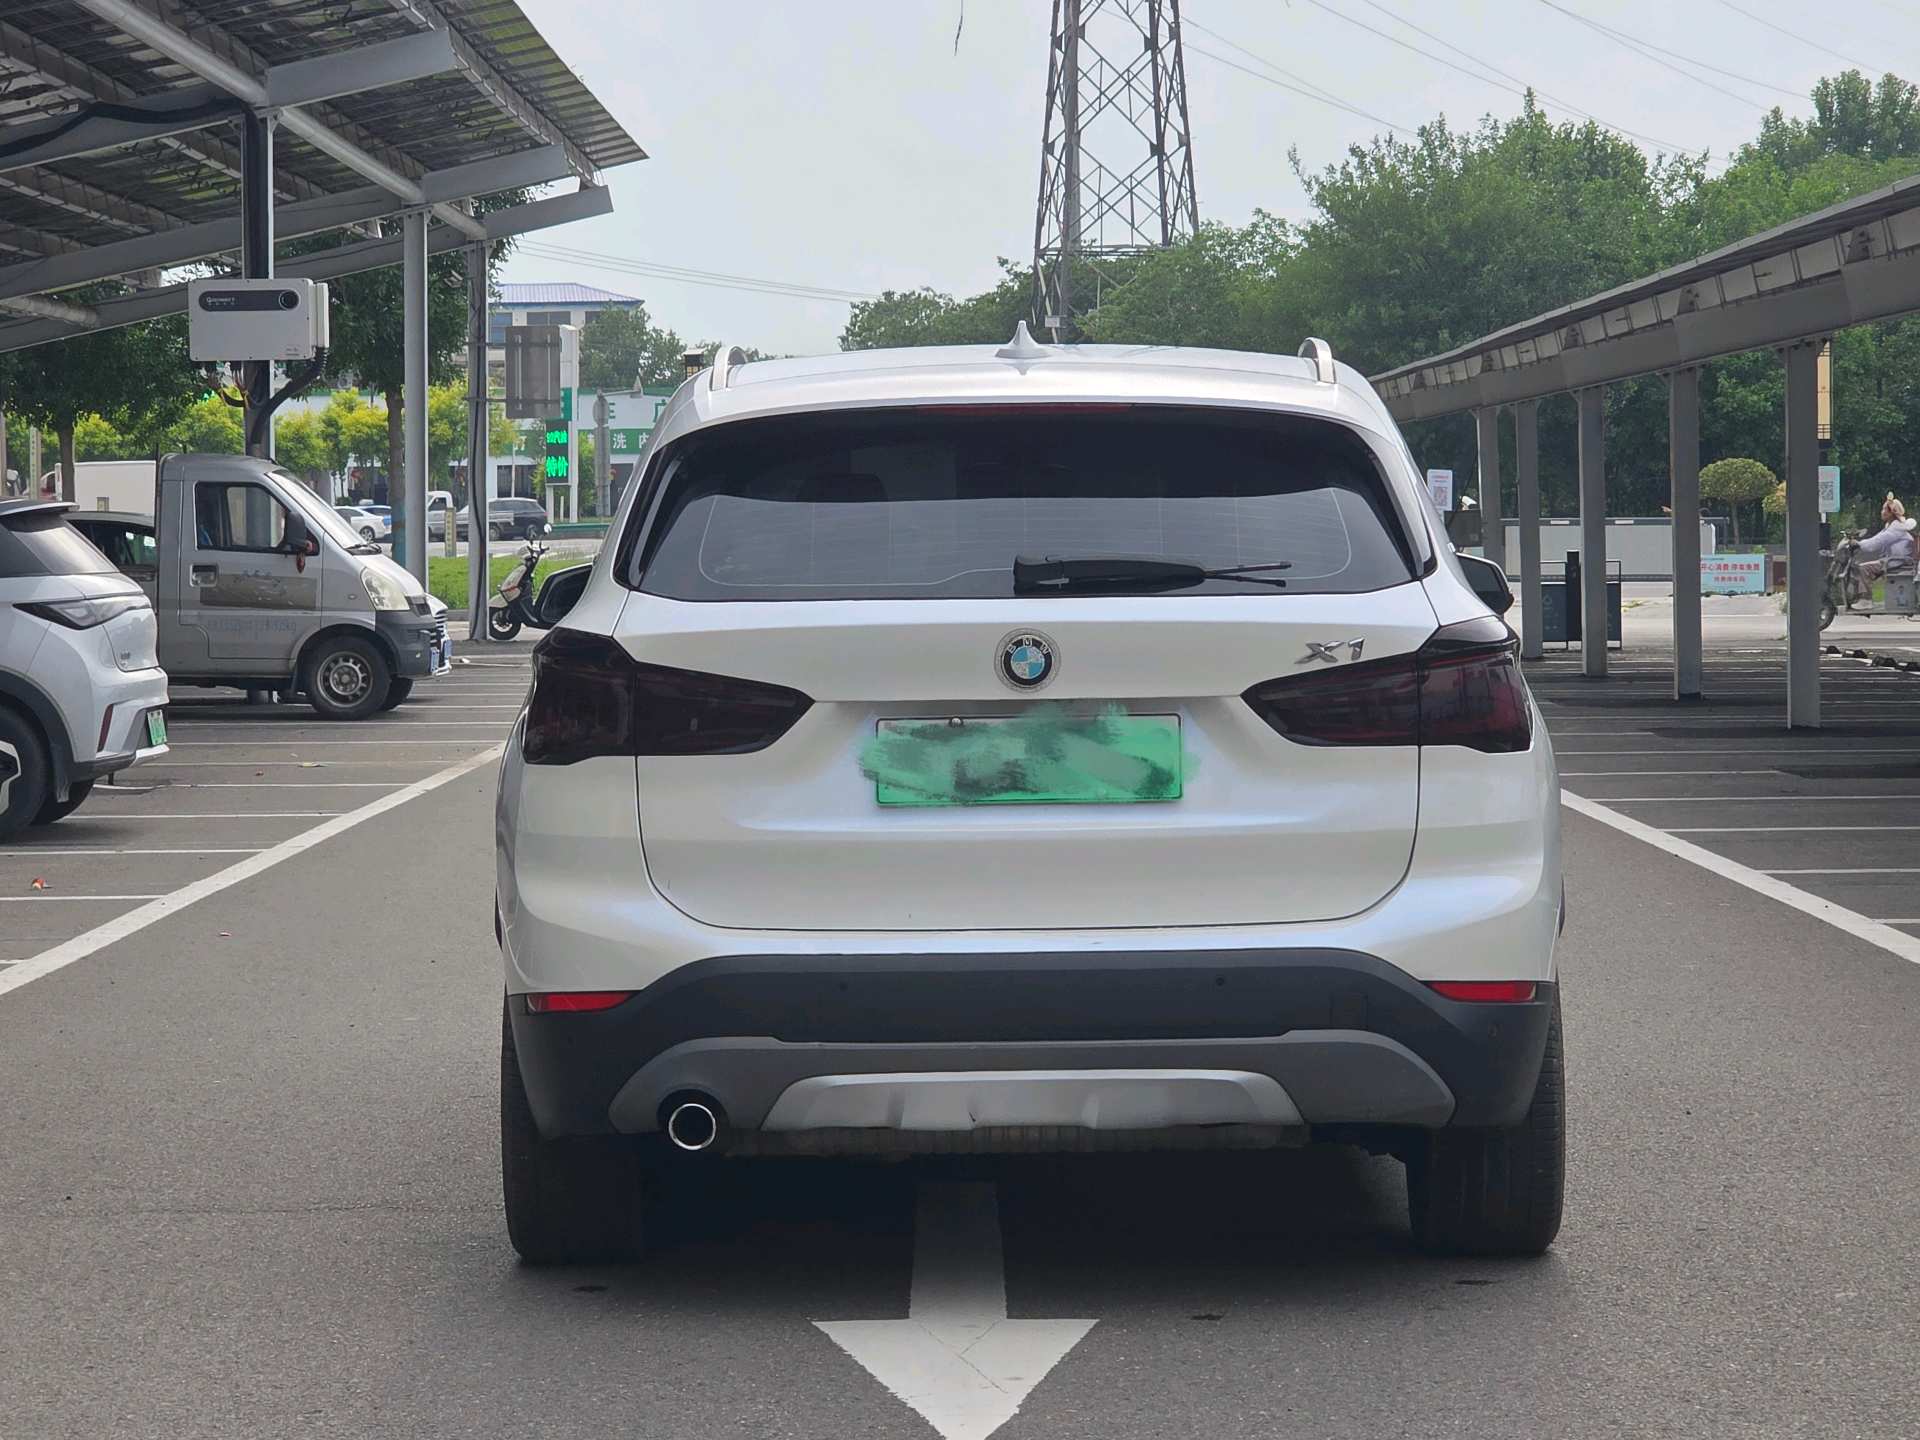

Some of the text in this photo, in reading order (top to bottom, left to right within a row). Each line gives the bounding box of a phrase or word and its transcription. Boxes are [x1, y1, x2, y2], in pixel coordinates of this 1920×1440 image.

[546, 455, 569, 478] 特价
[1007, 638, 1051, 655] BMW
[1294, 637, 1366, 664] X1
